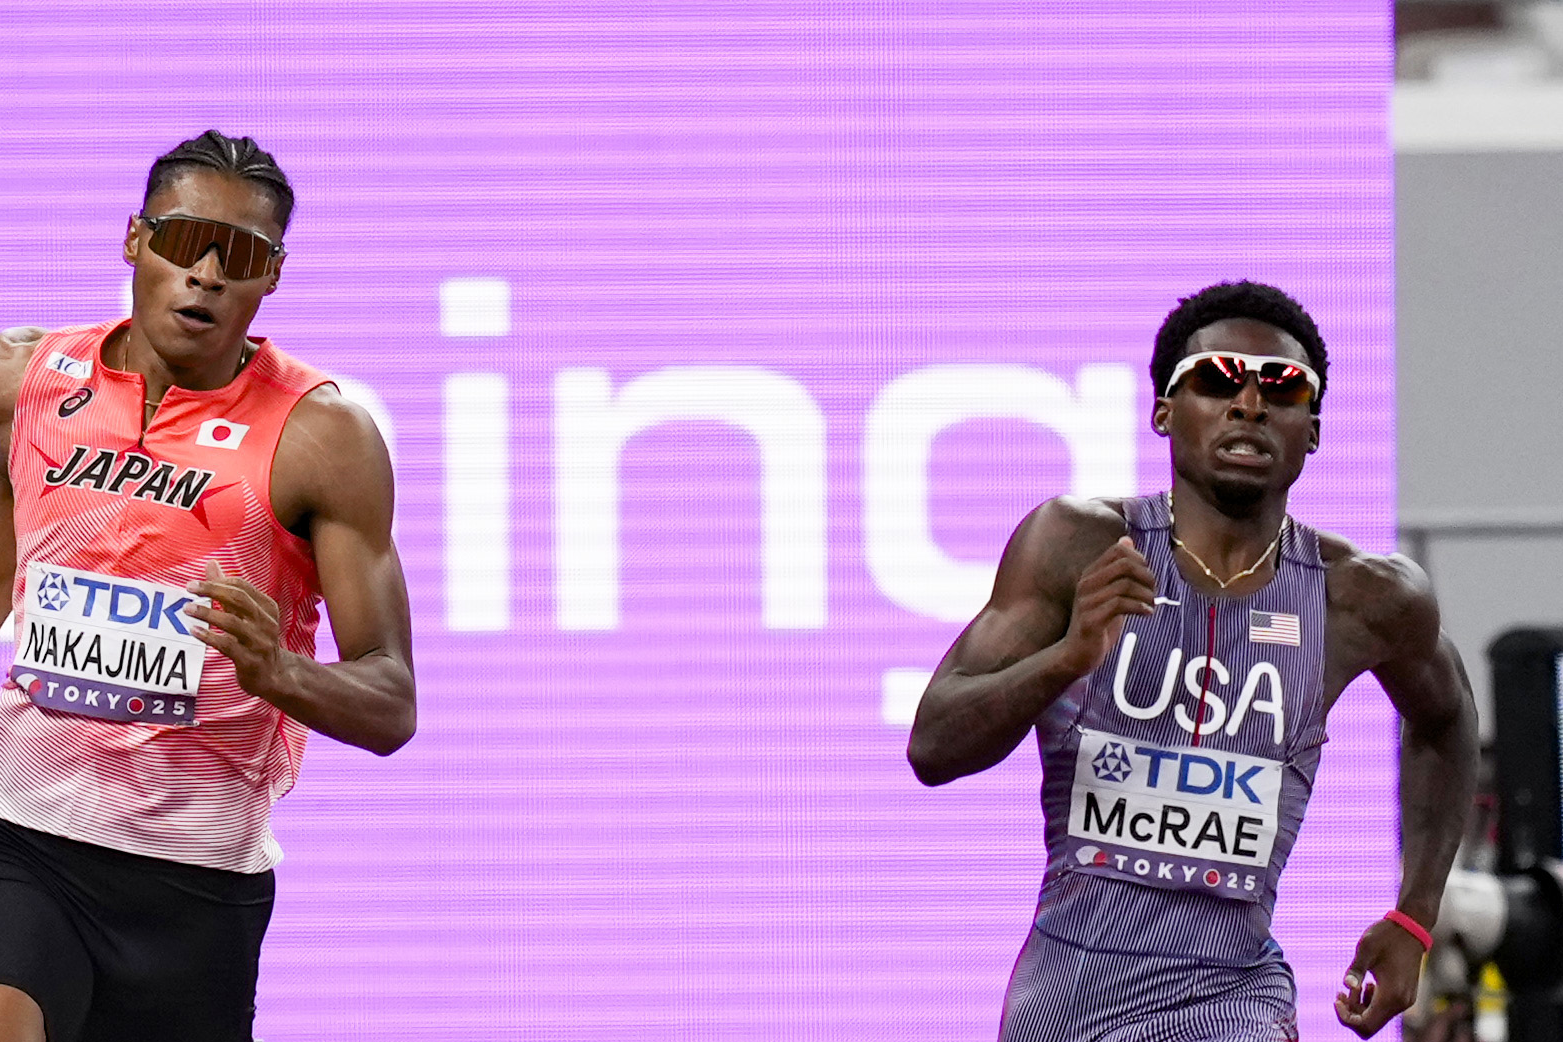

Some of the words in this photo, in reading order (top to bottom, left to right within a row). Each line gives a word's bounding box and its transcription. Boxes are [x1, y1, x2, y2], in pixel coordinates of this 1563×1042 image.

[45, 444, 215, 511] JAPAN
[73, 576, 195, 636] TDK
[23, 621, 188, 691] NAKAJIMA
[1113, 632, 1285, 745] USA
[1134, 747, 1266, 806] TDK
[1083, 792, 1264, 858] McRAE
